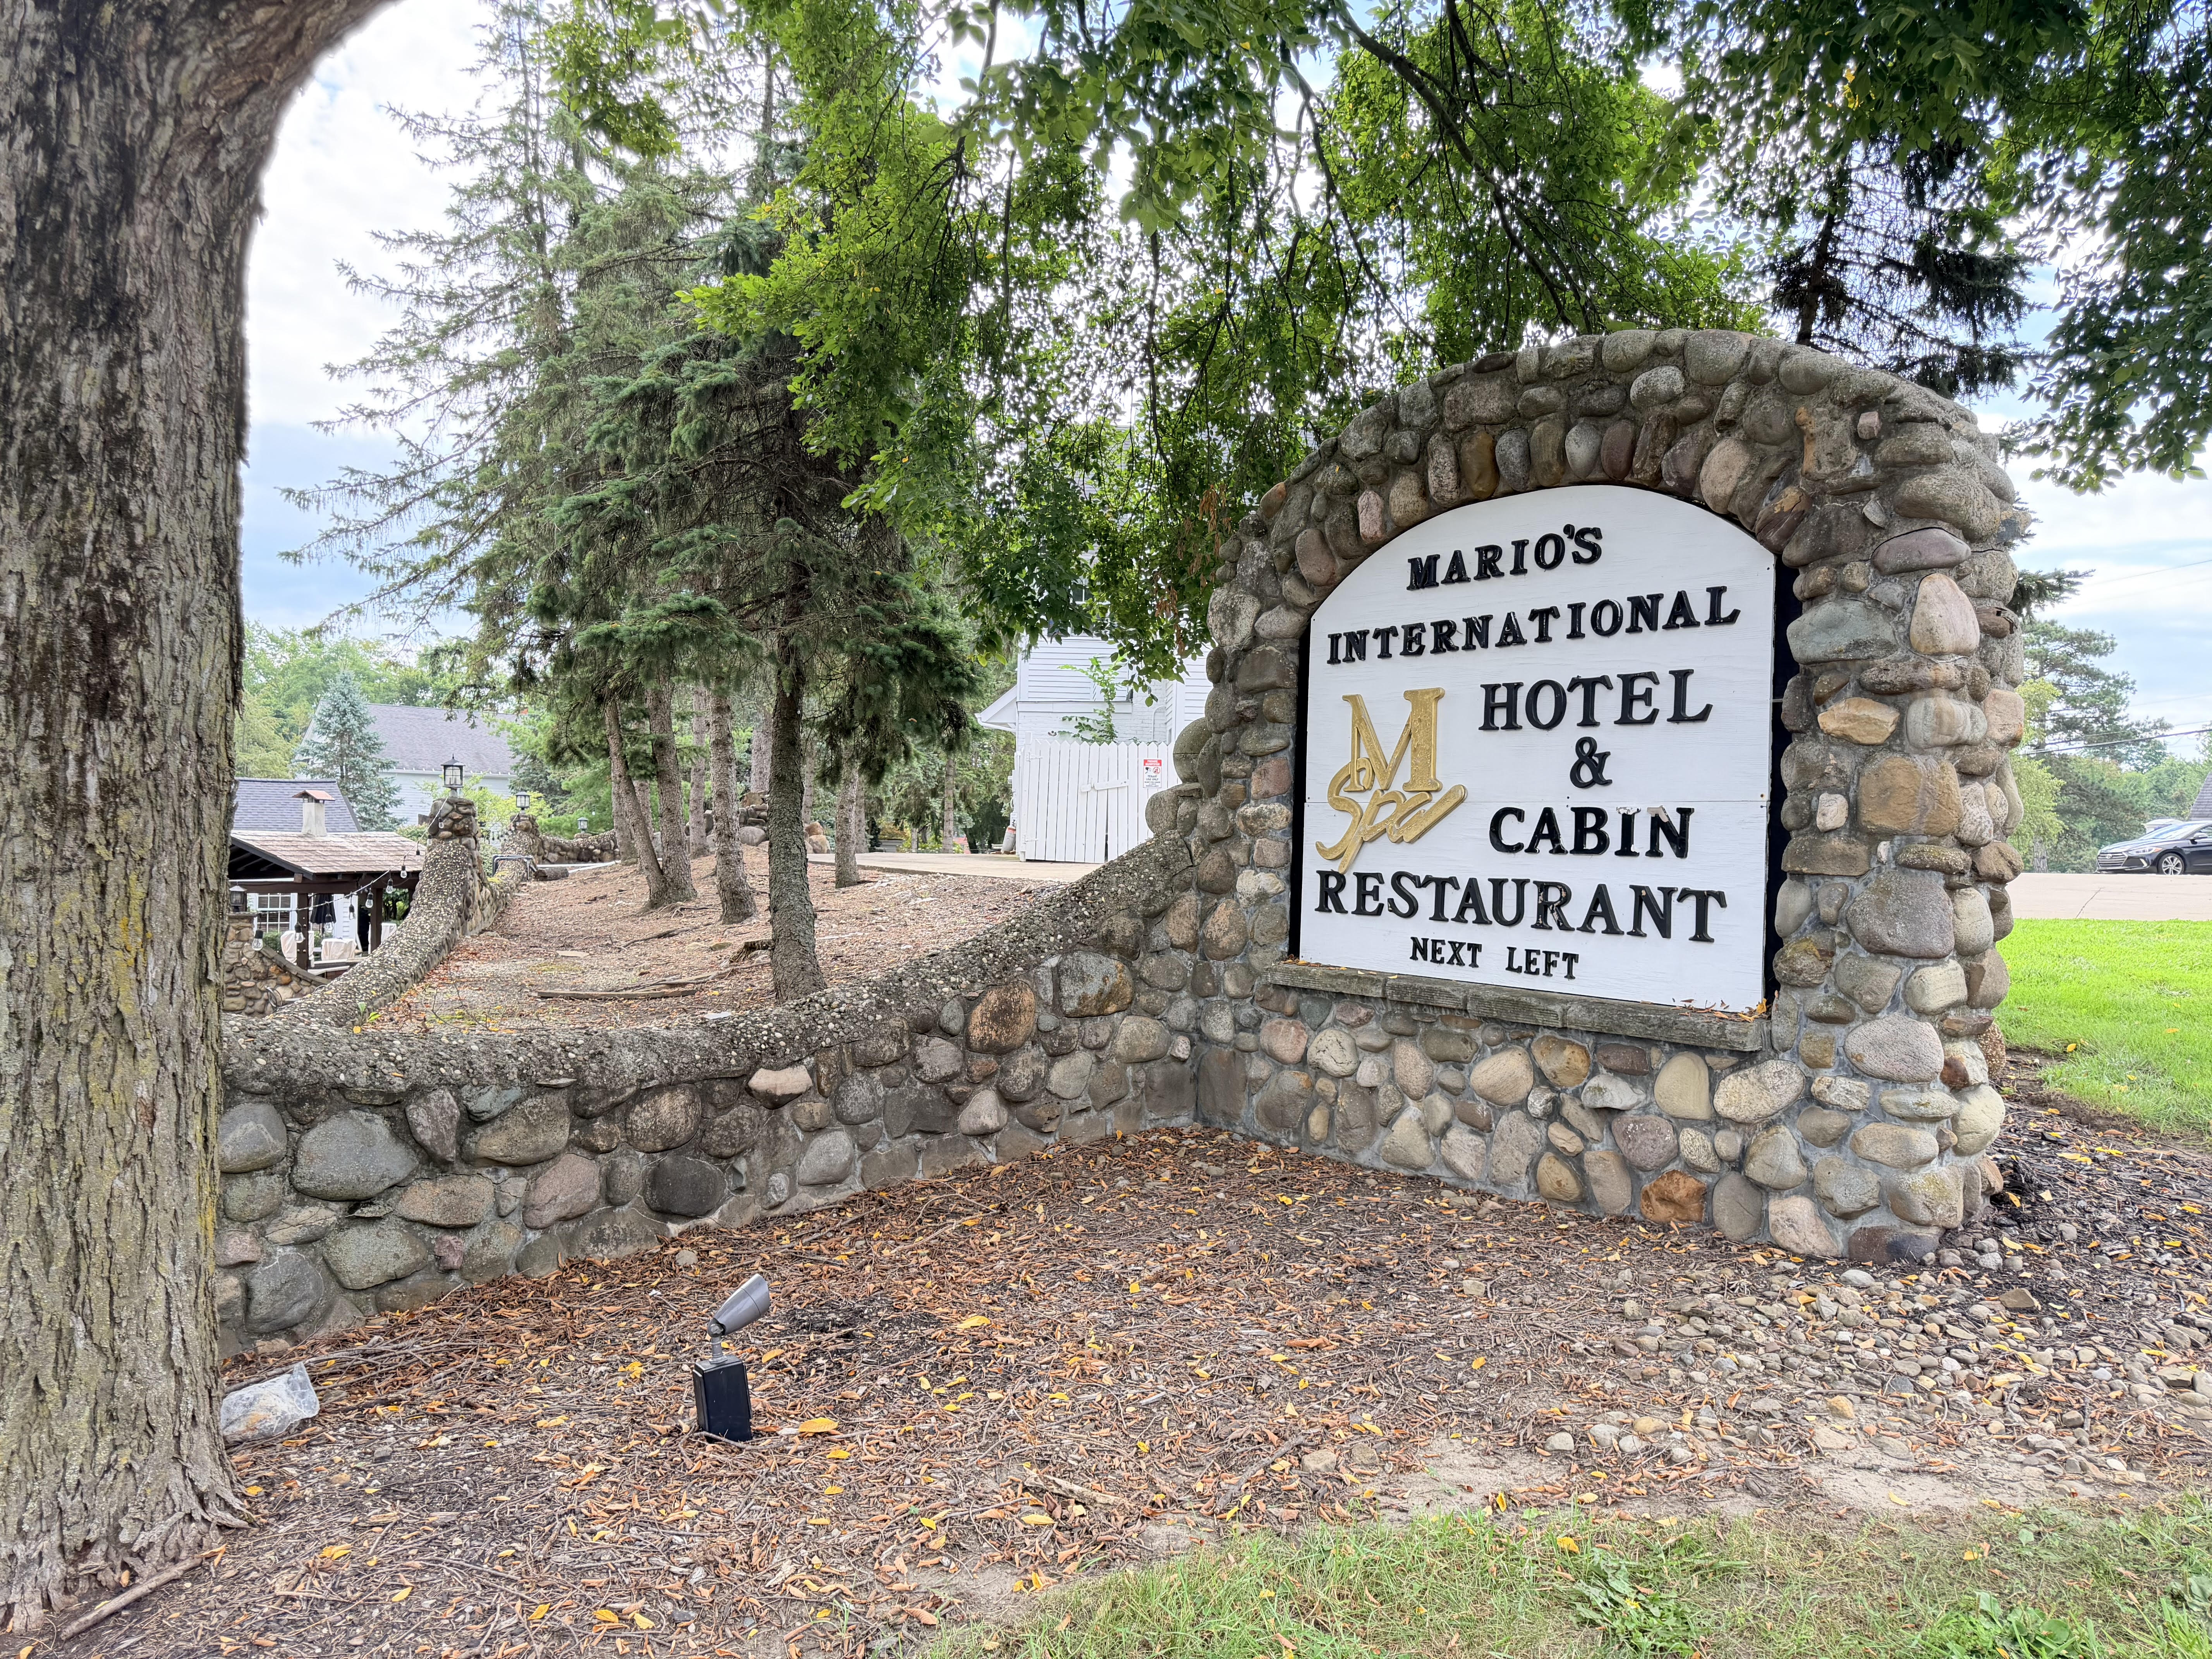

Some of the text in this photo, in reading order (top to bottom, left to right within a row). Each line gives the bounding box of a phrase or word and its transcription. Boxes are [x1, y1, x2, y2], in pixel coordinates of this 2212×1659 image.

[1406, 524, 1603, 591] MARIO'S
[1327, 586, 1741, 665] INTERNATIONAL
[1478, 668, 1713, 732] HOTEL
[1342, 687, 1445, 792] M
[1569, 736, 1613, 789] &
[1315, 757, 1468, 874] Spa
[1489, 805, 1695, 859] CABIN
[1314, 869, 1727, 943] RESTAURANT
[1410, 936, 1579, 980] NEXT LEFT
